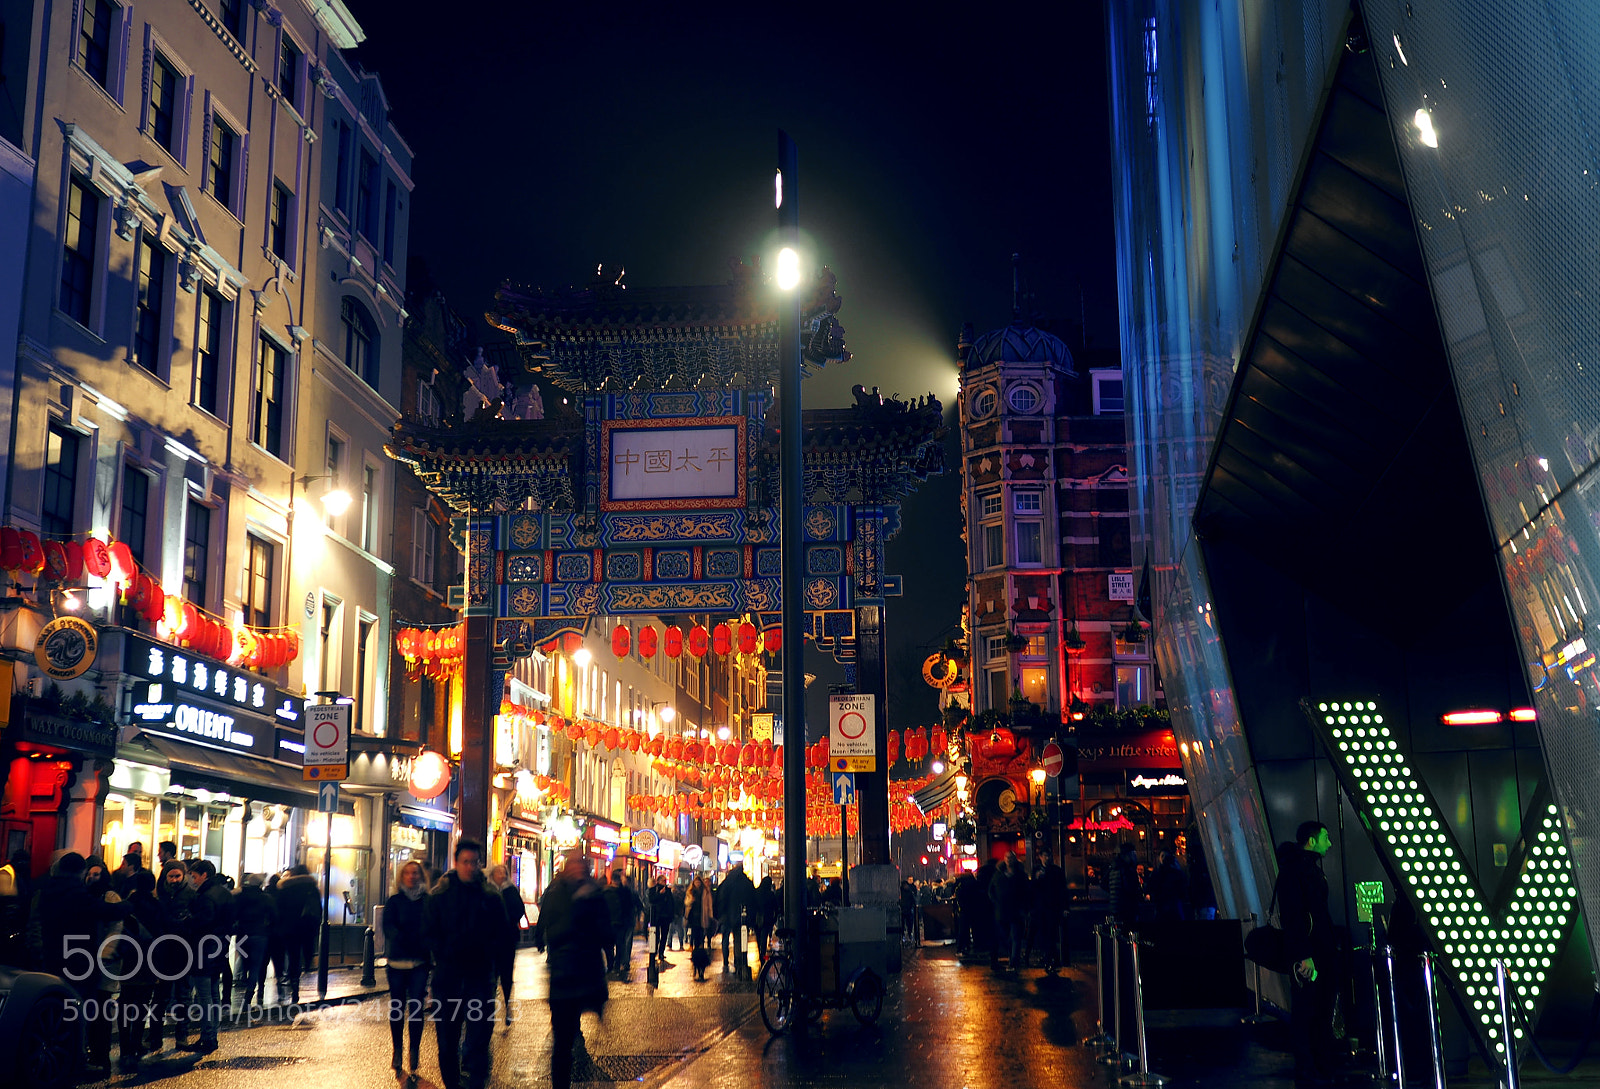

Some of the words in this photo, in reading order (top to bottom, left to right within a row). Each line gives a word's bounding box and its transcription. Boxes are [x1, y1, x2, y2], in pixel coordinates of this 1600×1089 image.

[614, 447, 733, 475] 中國太平
[47, 667, 76, 677] LONDON
[839, 703, 865, 711] ZONE
[31, 718, 60, 735] WAXY
[63, 725, 113, 746] O'CONNOR'S
[175, 704, 235, 742] ORIENT
